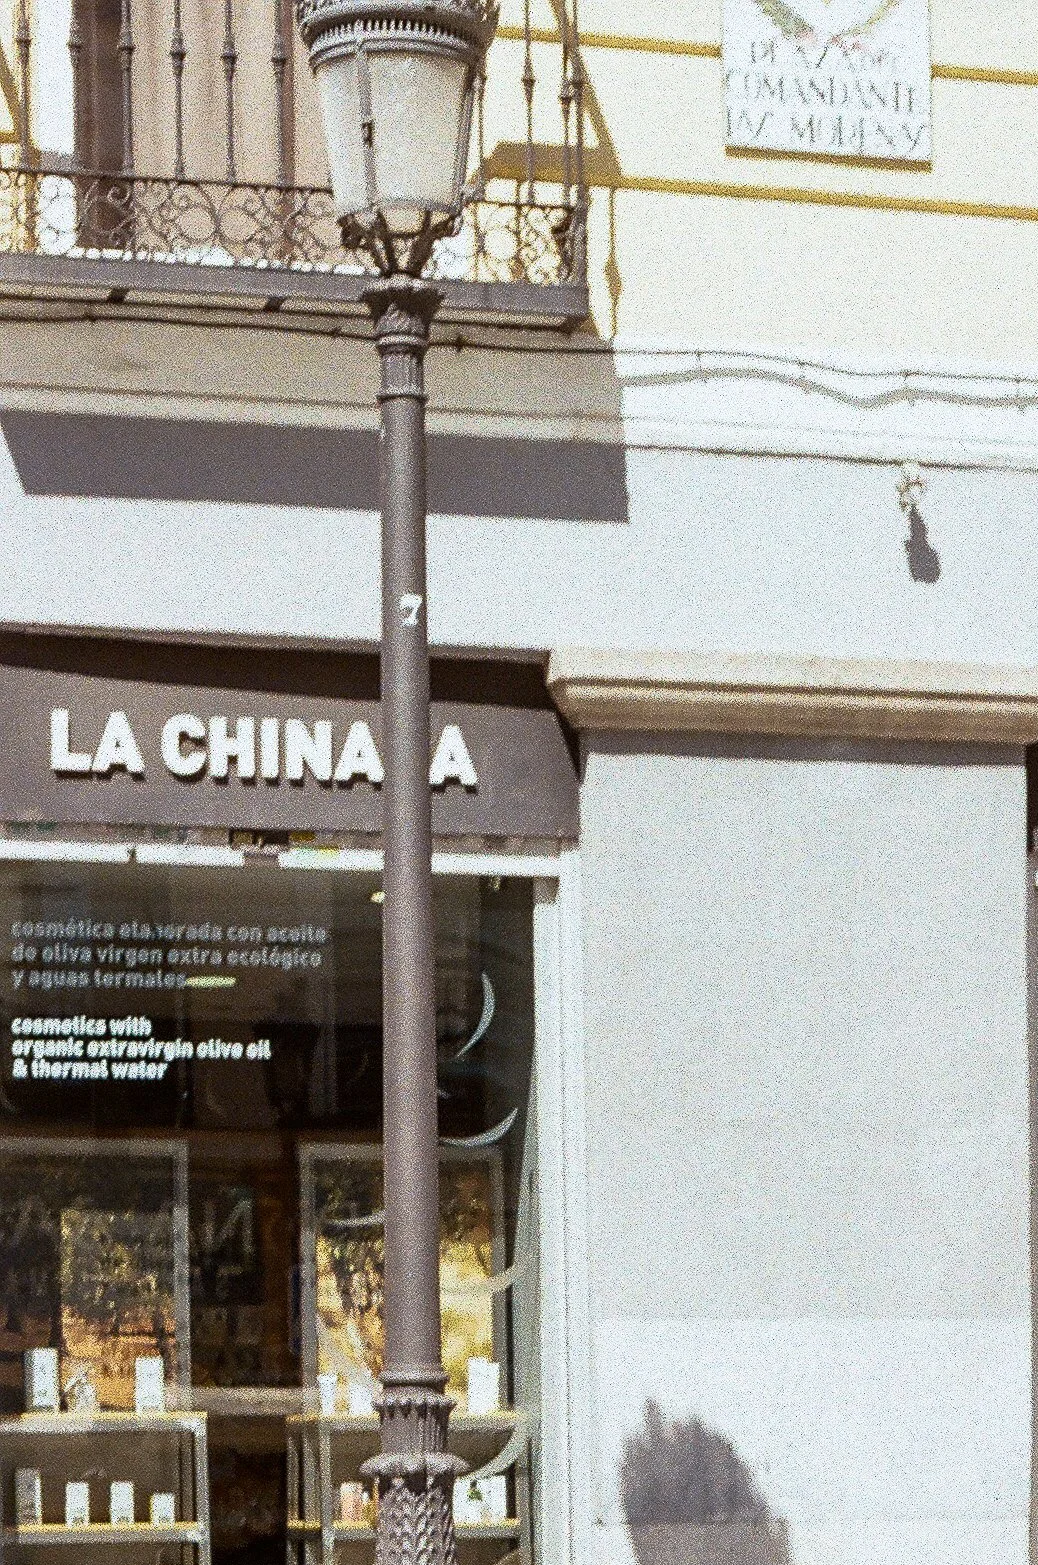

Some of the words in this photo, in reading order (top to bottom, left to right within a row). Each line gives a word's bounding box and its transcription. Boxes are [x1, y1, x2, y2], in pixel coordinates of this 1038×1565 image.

[50, 707, 144, 774] LA
[161, 713, 479, 787] CHINAA
[11, 917, 115, 939] cosmética
[227, 925, 261, 941] con
[268, 924, 327, 943] aceite
[11, 942, 36, 962] de
[42, 942, 91, 963] oliva
[97, 943, 162, 967] virgen
[167, 947, 222, 966] extra
[227, 946, 321, 971] ecológico
[11, 969, 25, 990] y
[28, 970, 89, 990] aguas
[93, 969, 187, 989] termales
[11, 1015, 106, 1036] cosmetics
[109, 1014, 152, 1036] with
[11, 1036, 84, 1059] organic
[86, 1037, 194, 1061] extravirgin
[196, 1038, 244, 1060] olive
[246, 1039, 272, 1060] oil
[12, 1058, 28, 1079] &
[31, 1058, 108, 1080] thermal
[111, 1060, 169, 1080] water
